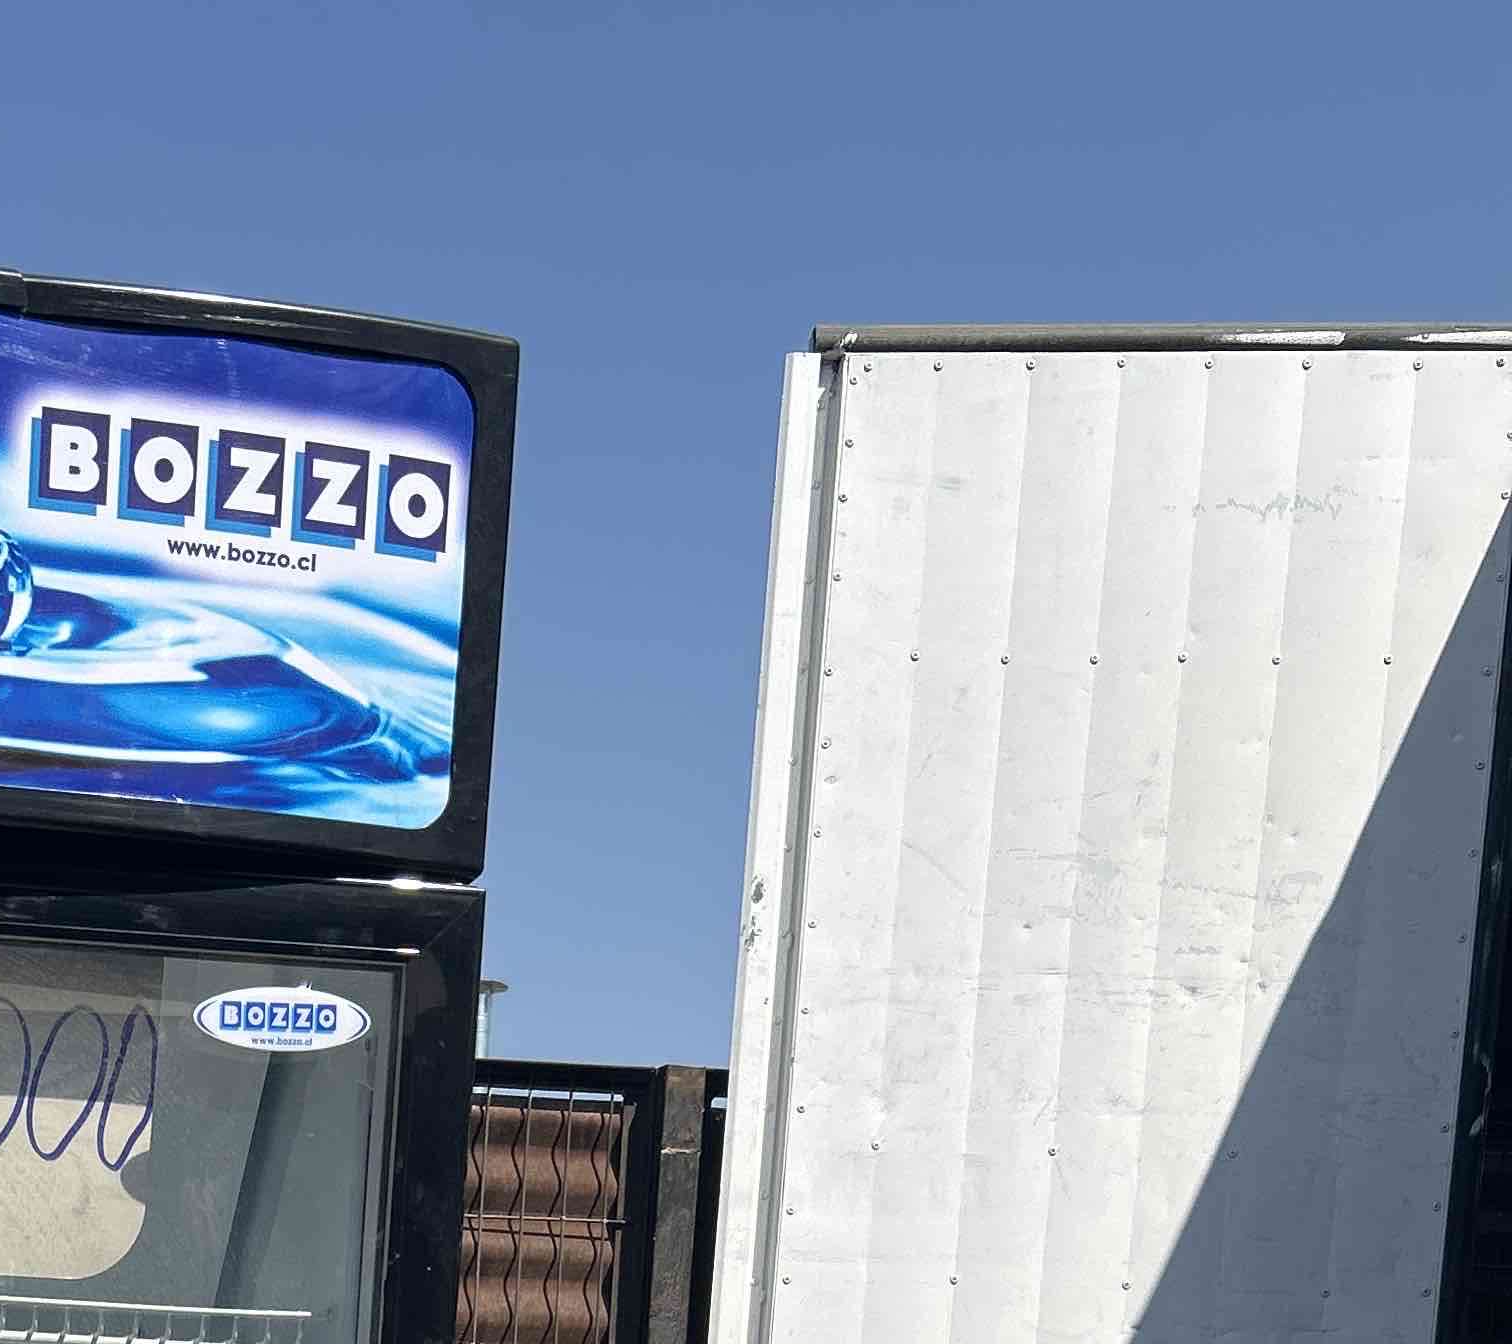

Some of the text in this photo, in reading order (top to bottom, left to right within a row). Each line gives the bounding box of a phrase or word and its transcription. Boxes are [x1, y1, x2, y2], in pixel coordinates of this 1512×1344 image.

[39, 410, 451, 550] BOZZO
[167, 539, 317, 572] www.bozzo.cl
[221, 1002, 337, 1031] BOZZO
